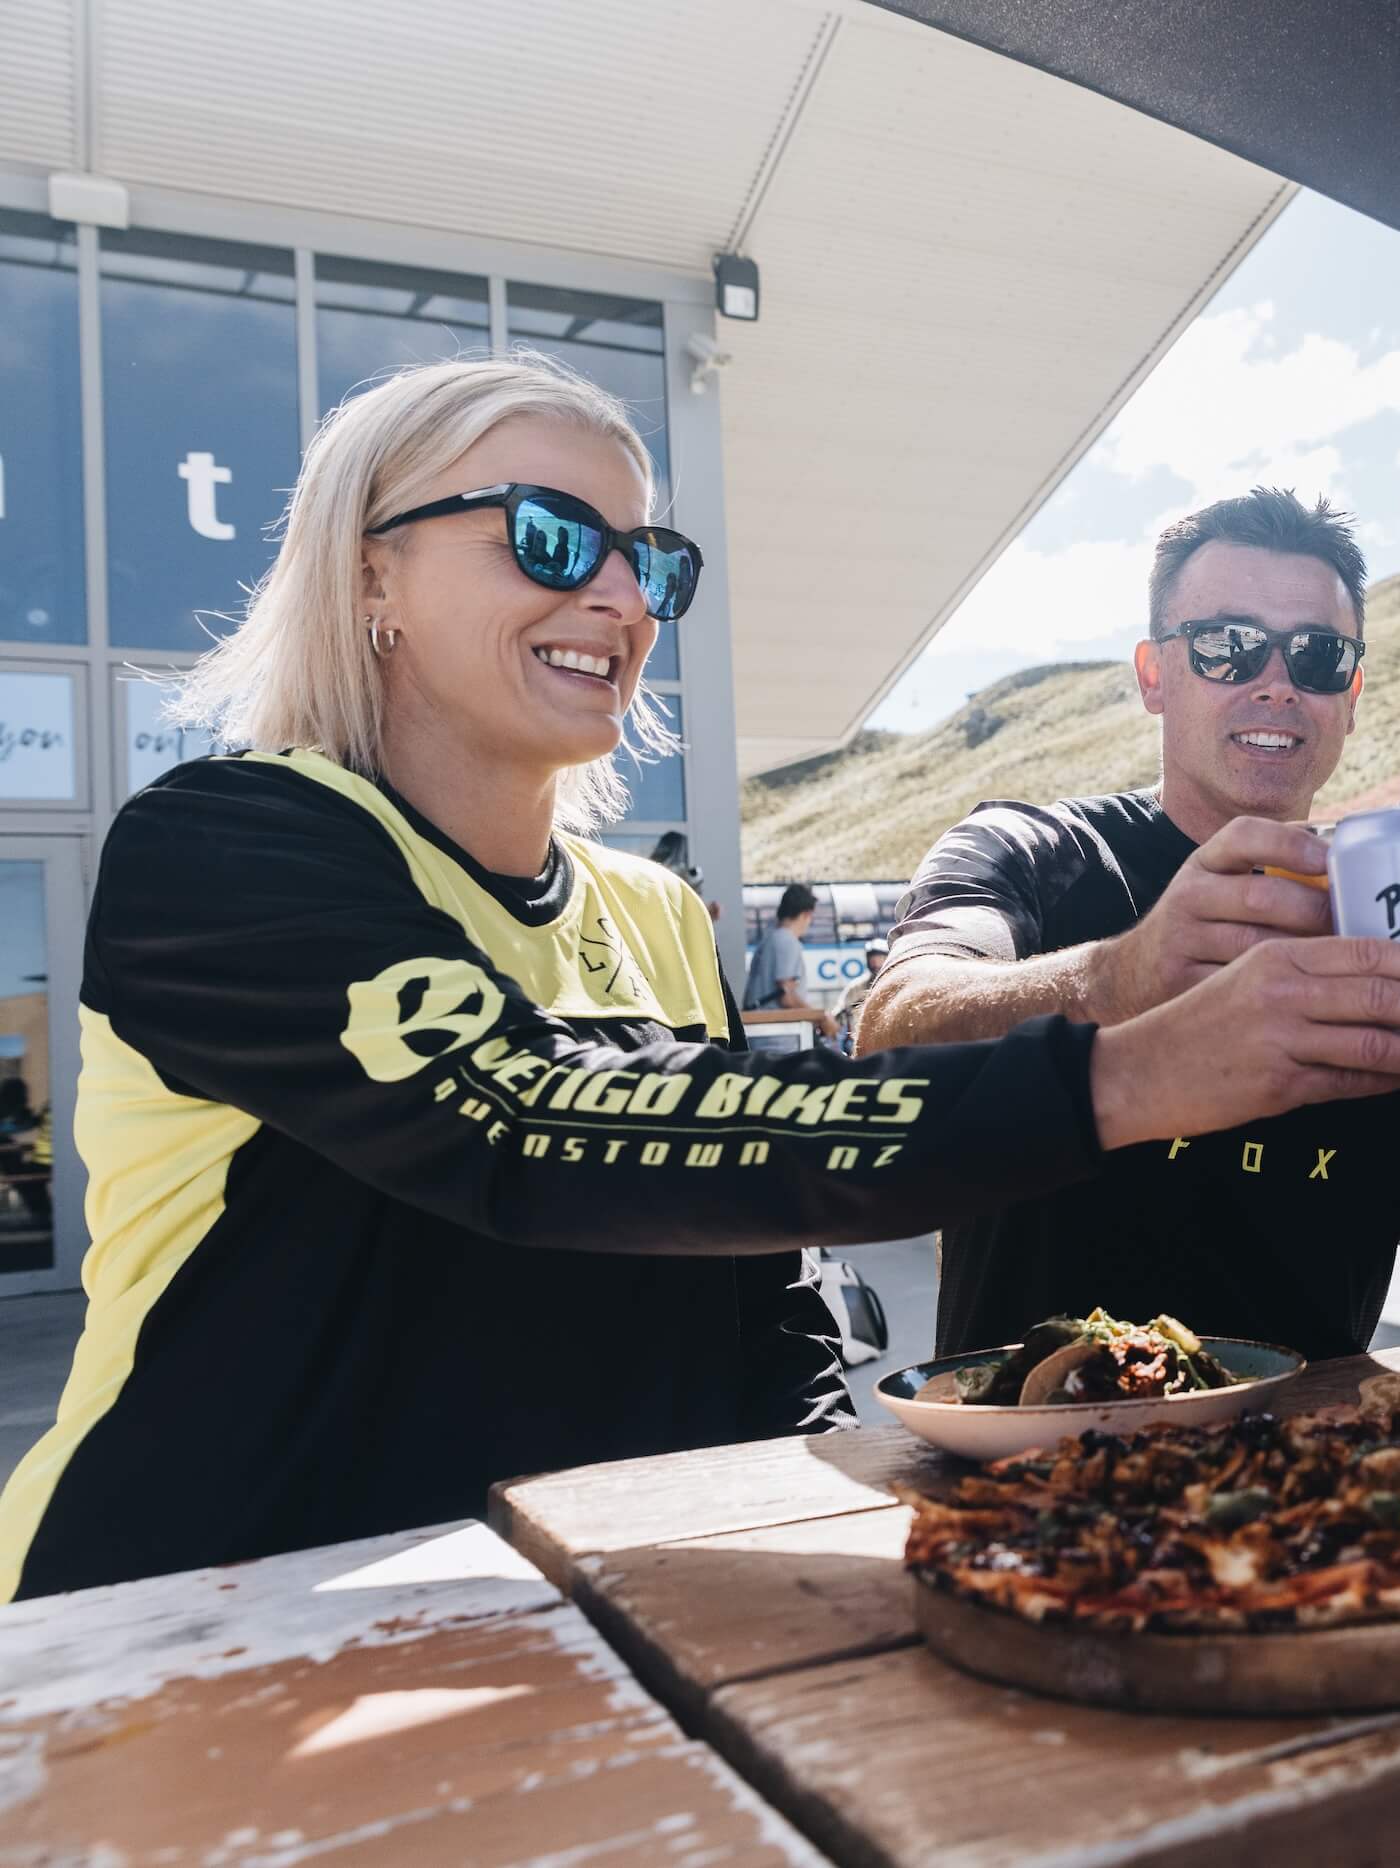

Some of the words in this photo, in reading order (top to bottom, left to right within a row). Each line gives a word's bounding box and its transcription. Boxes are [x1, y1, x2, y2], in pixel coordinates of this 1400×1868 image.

[434, 1077, 769, 1167] QUENSTOWN
[471, 1036, 692, 1115] VETIGO
[695, 1073, 930, 1125] BIKES
[1167, 1136, 1337, 1180] FOX
